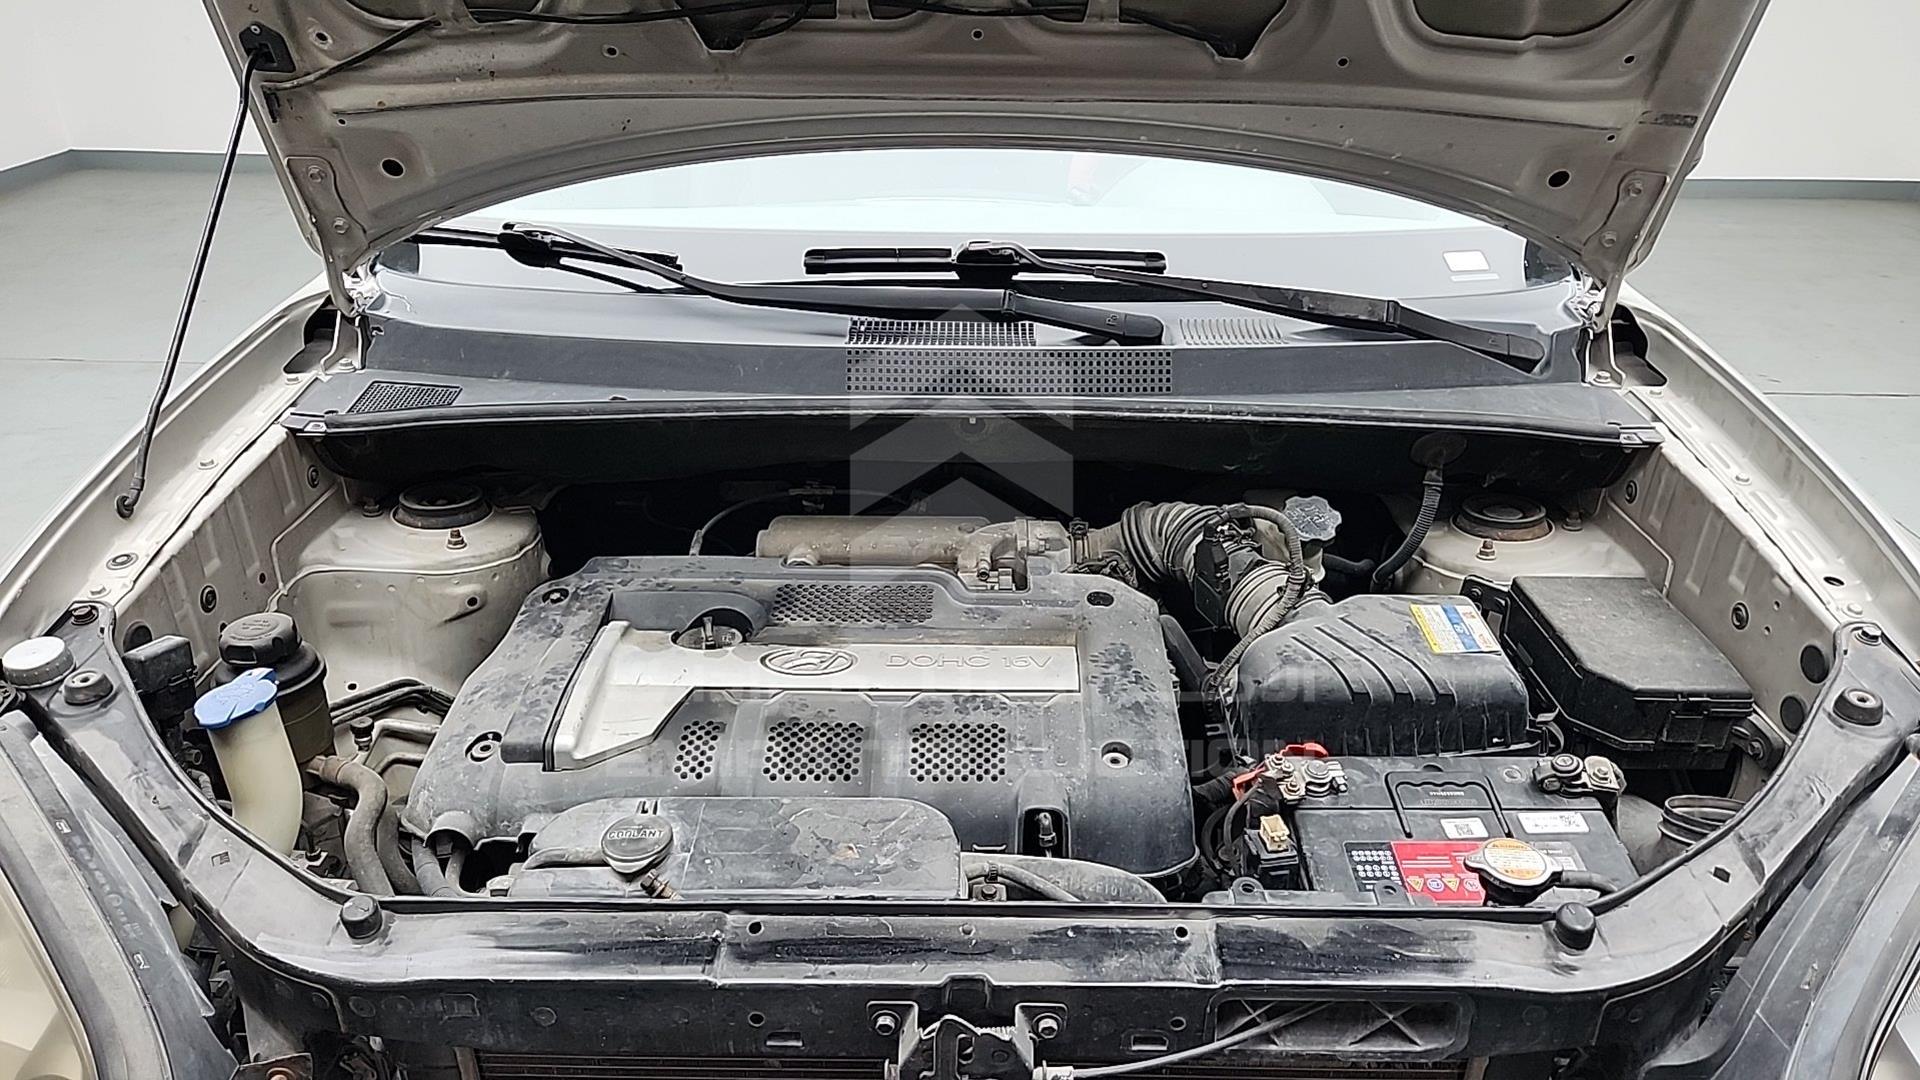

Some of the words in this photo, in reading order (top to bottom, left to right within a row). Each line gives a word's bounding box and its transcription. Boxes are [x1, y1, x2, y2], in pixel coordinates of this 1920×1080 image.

[884, 653, 992, 669] DOHC
[1001, 653, 1054, 669] 16V
[607, 828, 664, 840] COOLANT
